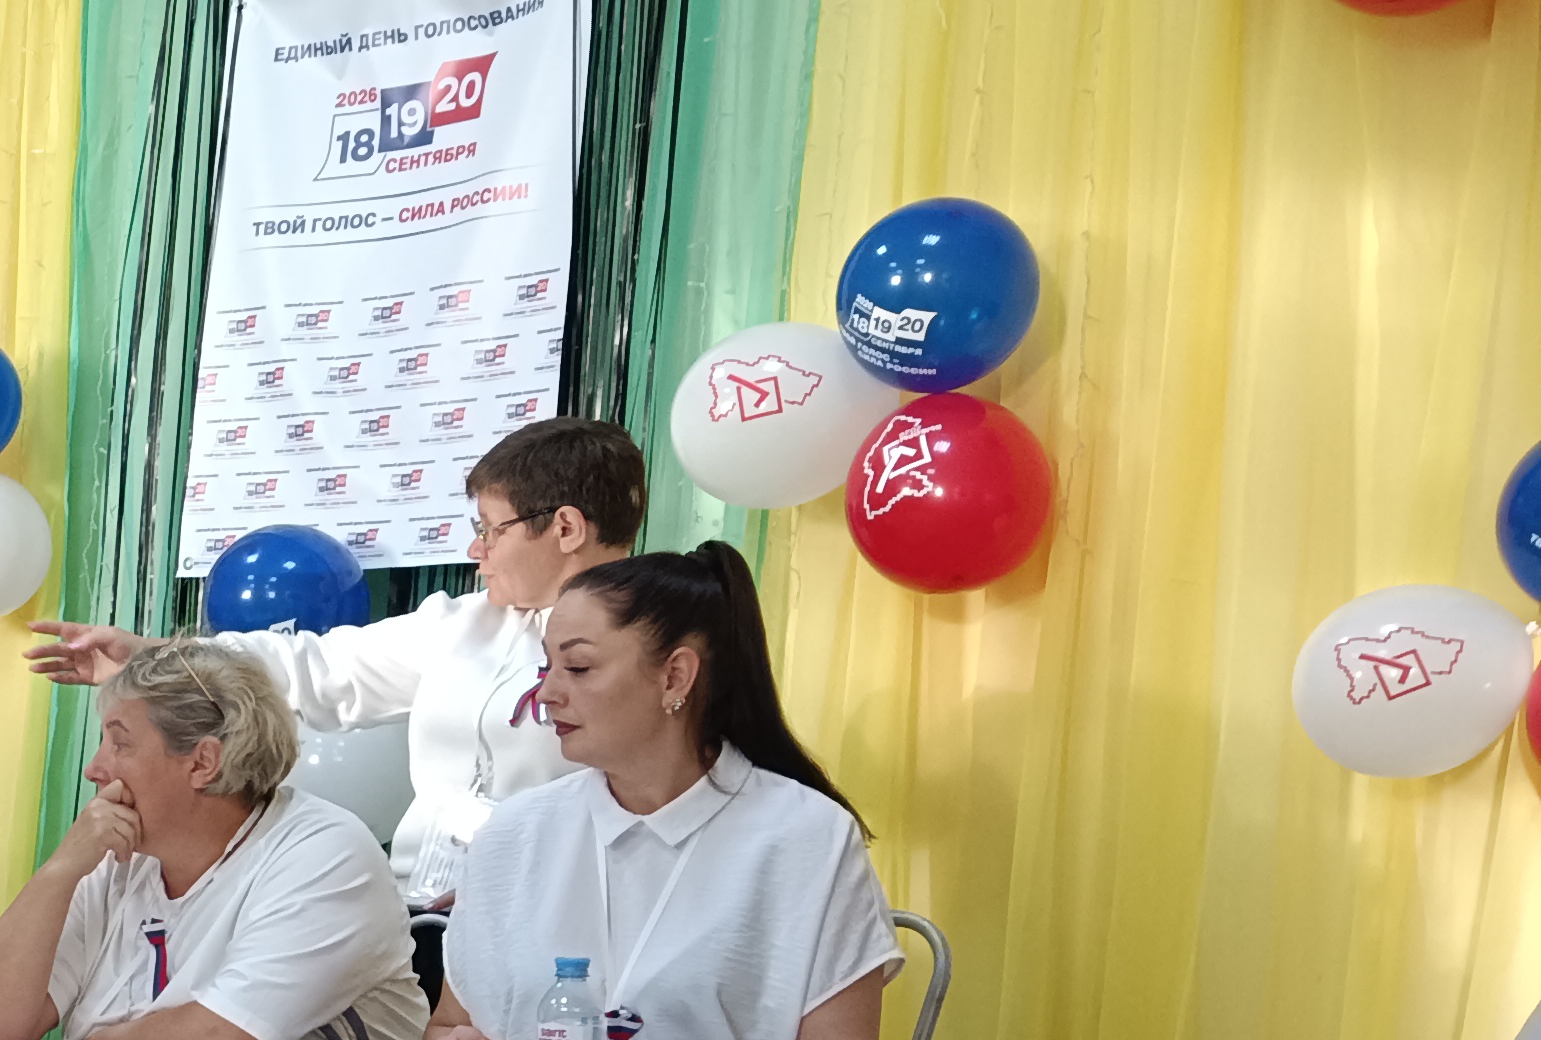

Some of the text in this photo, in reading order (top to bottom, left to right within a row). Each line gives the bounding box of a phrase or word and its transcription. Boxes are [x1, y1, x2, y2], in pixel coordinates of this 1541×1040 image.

[273, 0, 545, 63] ЕДИНЫЙ ДЕНЬ ГОЛОСОВАНИЯ
[334, 87, 378, 109] 2026
[434, 71, 483, 114] 20
[385, 99, 426, 139] 19
[336, 127, 376, 164] 18
[385, 141, 478, 174] СЕНТЯБРЯ
[253, 215, 306, 237] ТВОЙ
[311, 212, 377, 234] ГОЛОС
[398, 201, 446, 224] СИЛА
[450, 183, 530, 214] РОССИИ!
[851, 313, 925, 334] 18 19 20
